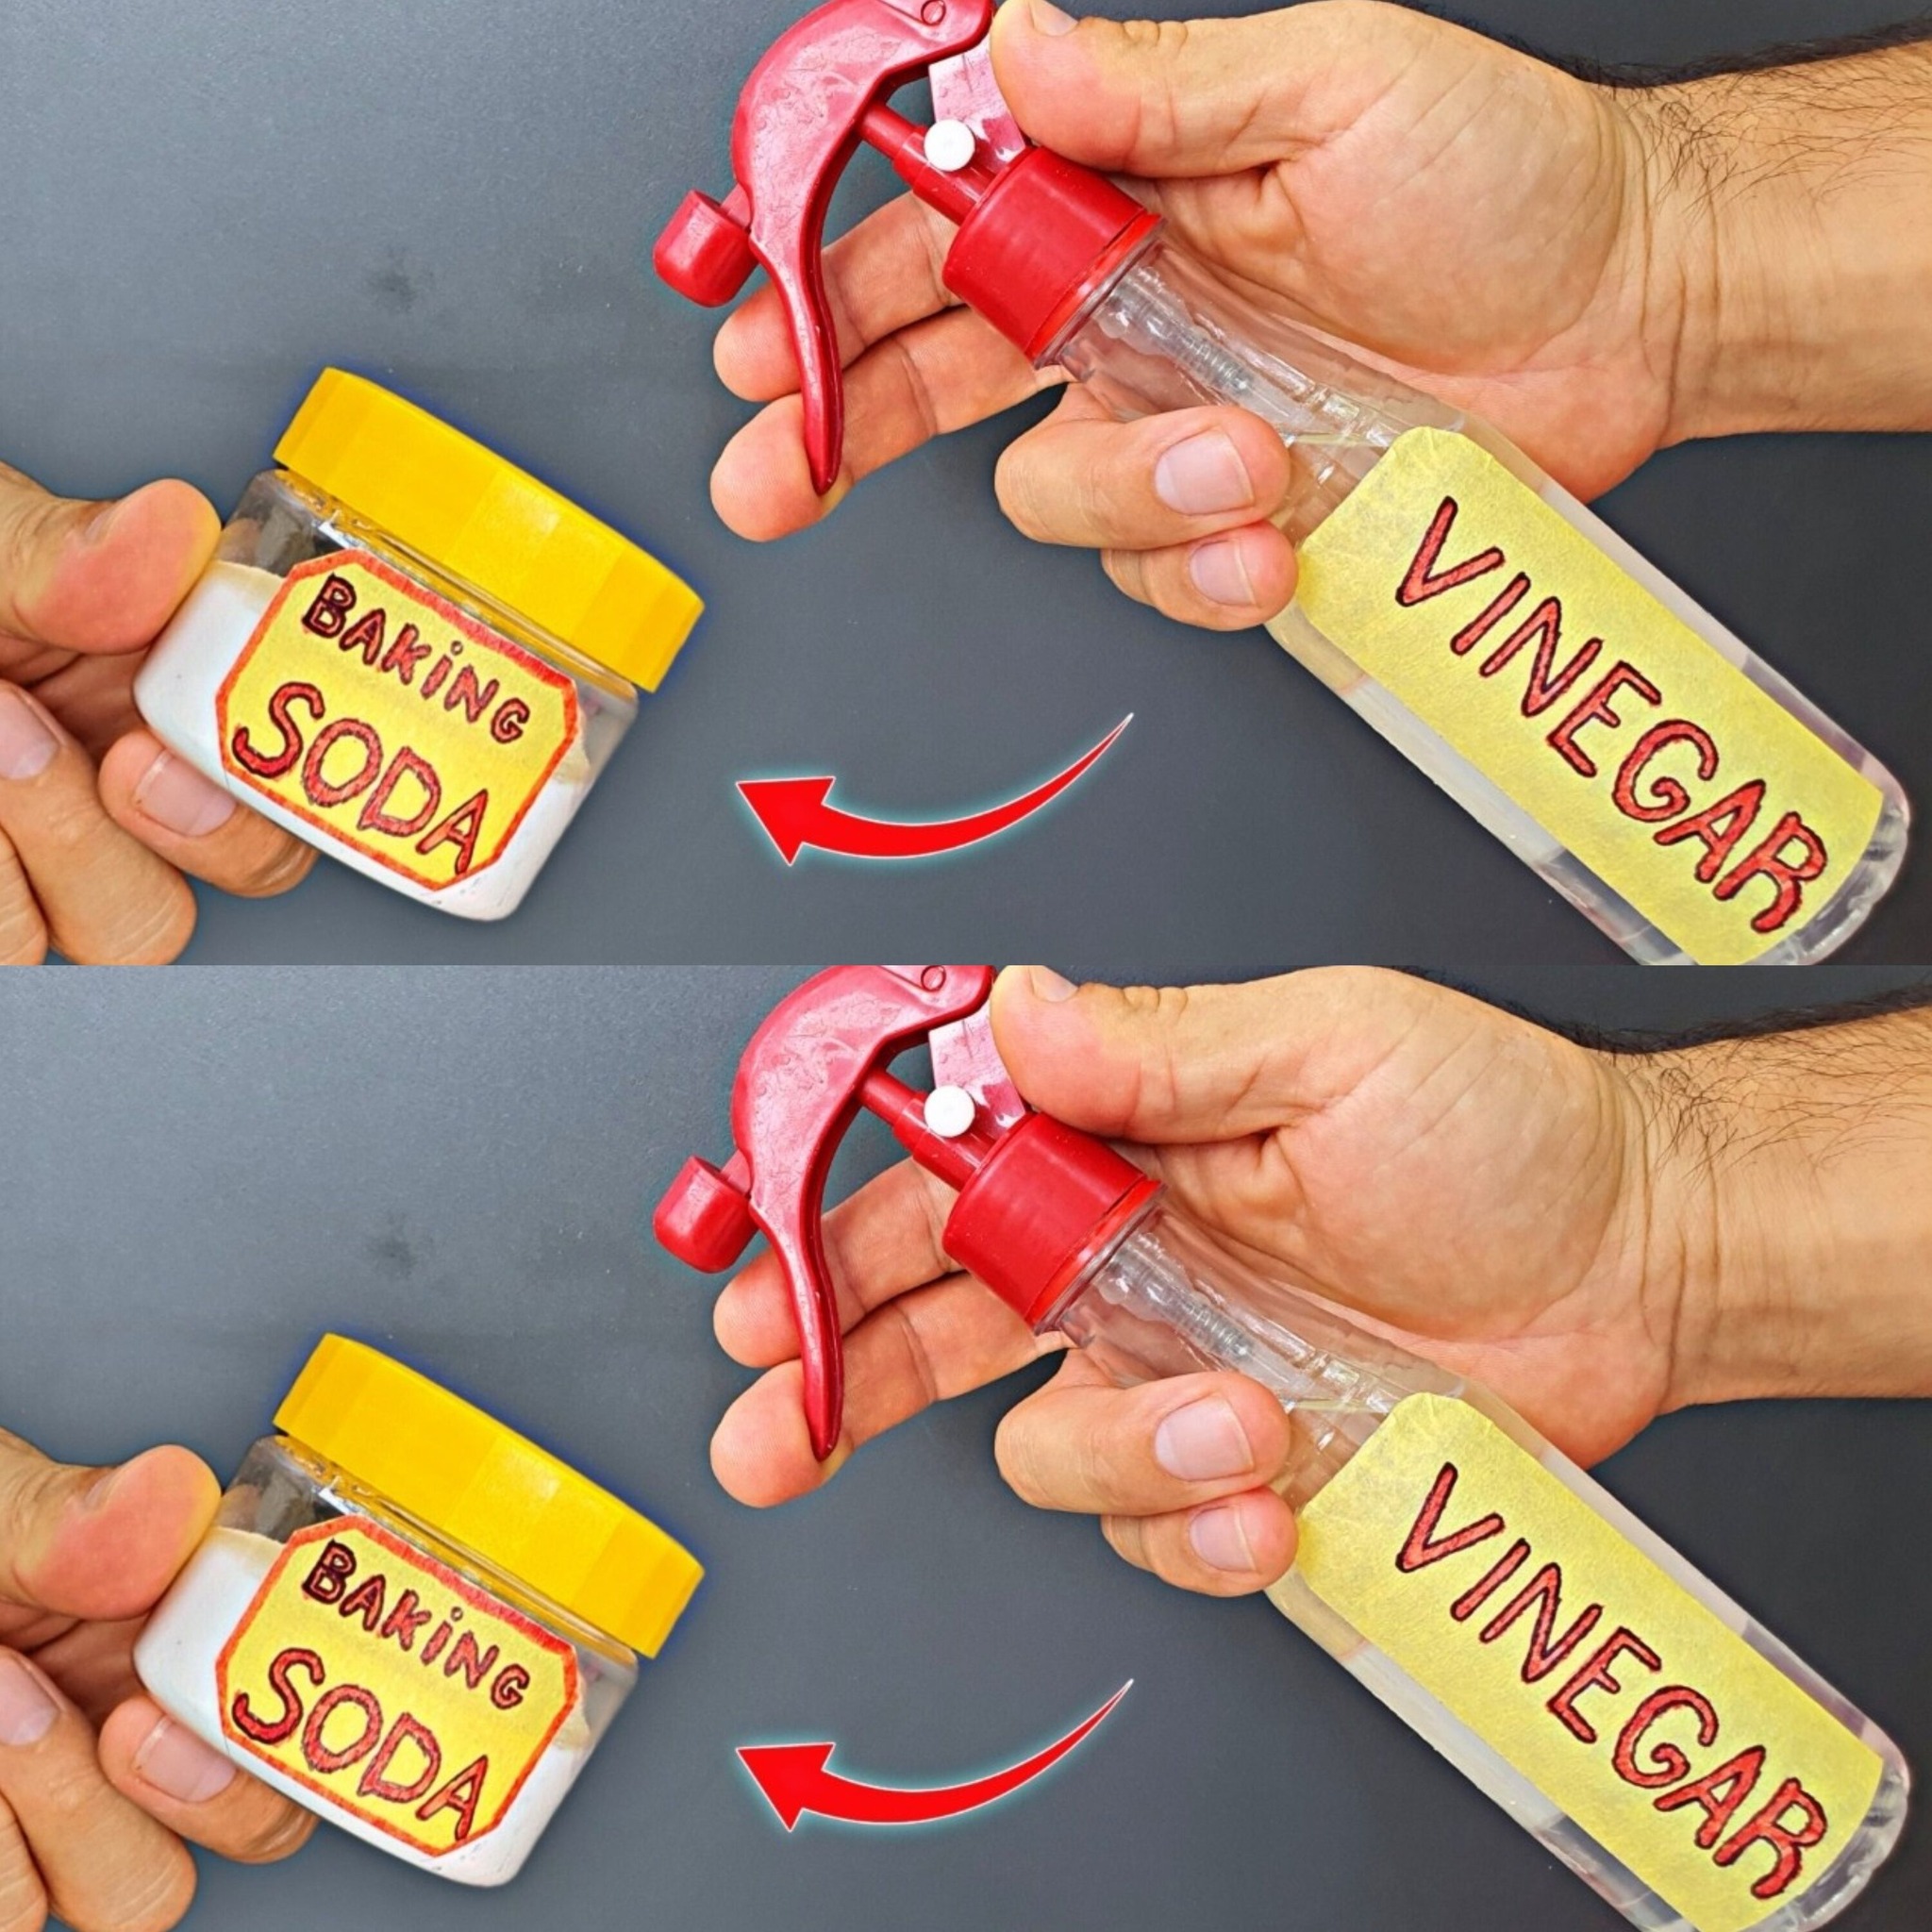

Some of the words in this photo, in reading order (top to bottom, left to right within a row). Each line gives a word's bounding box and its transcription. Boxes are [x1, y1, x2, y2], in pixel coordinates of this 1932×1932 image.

[232, 682, 488, 875] SODA
[1395, 496, 1828, 934] VINEGAR
[232, 1648, 488, 1841] SODA
[1395, 1462, 1828, 1900] VINEGAR
